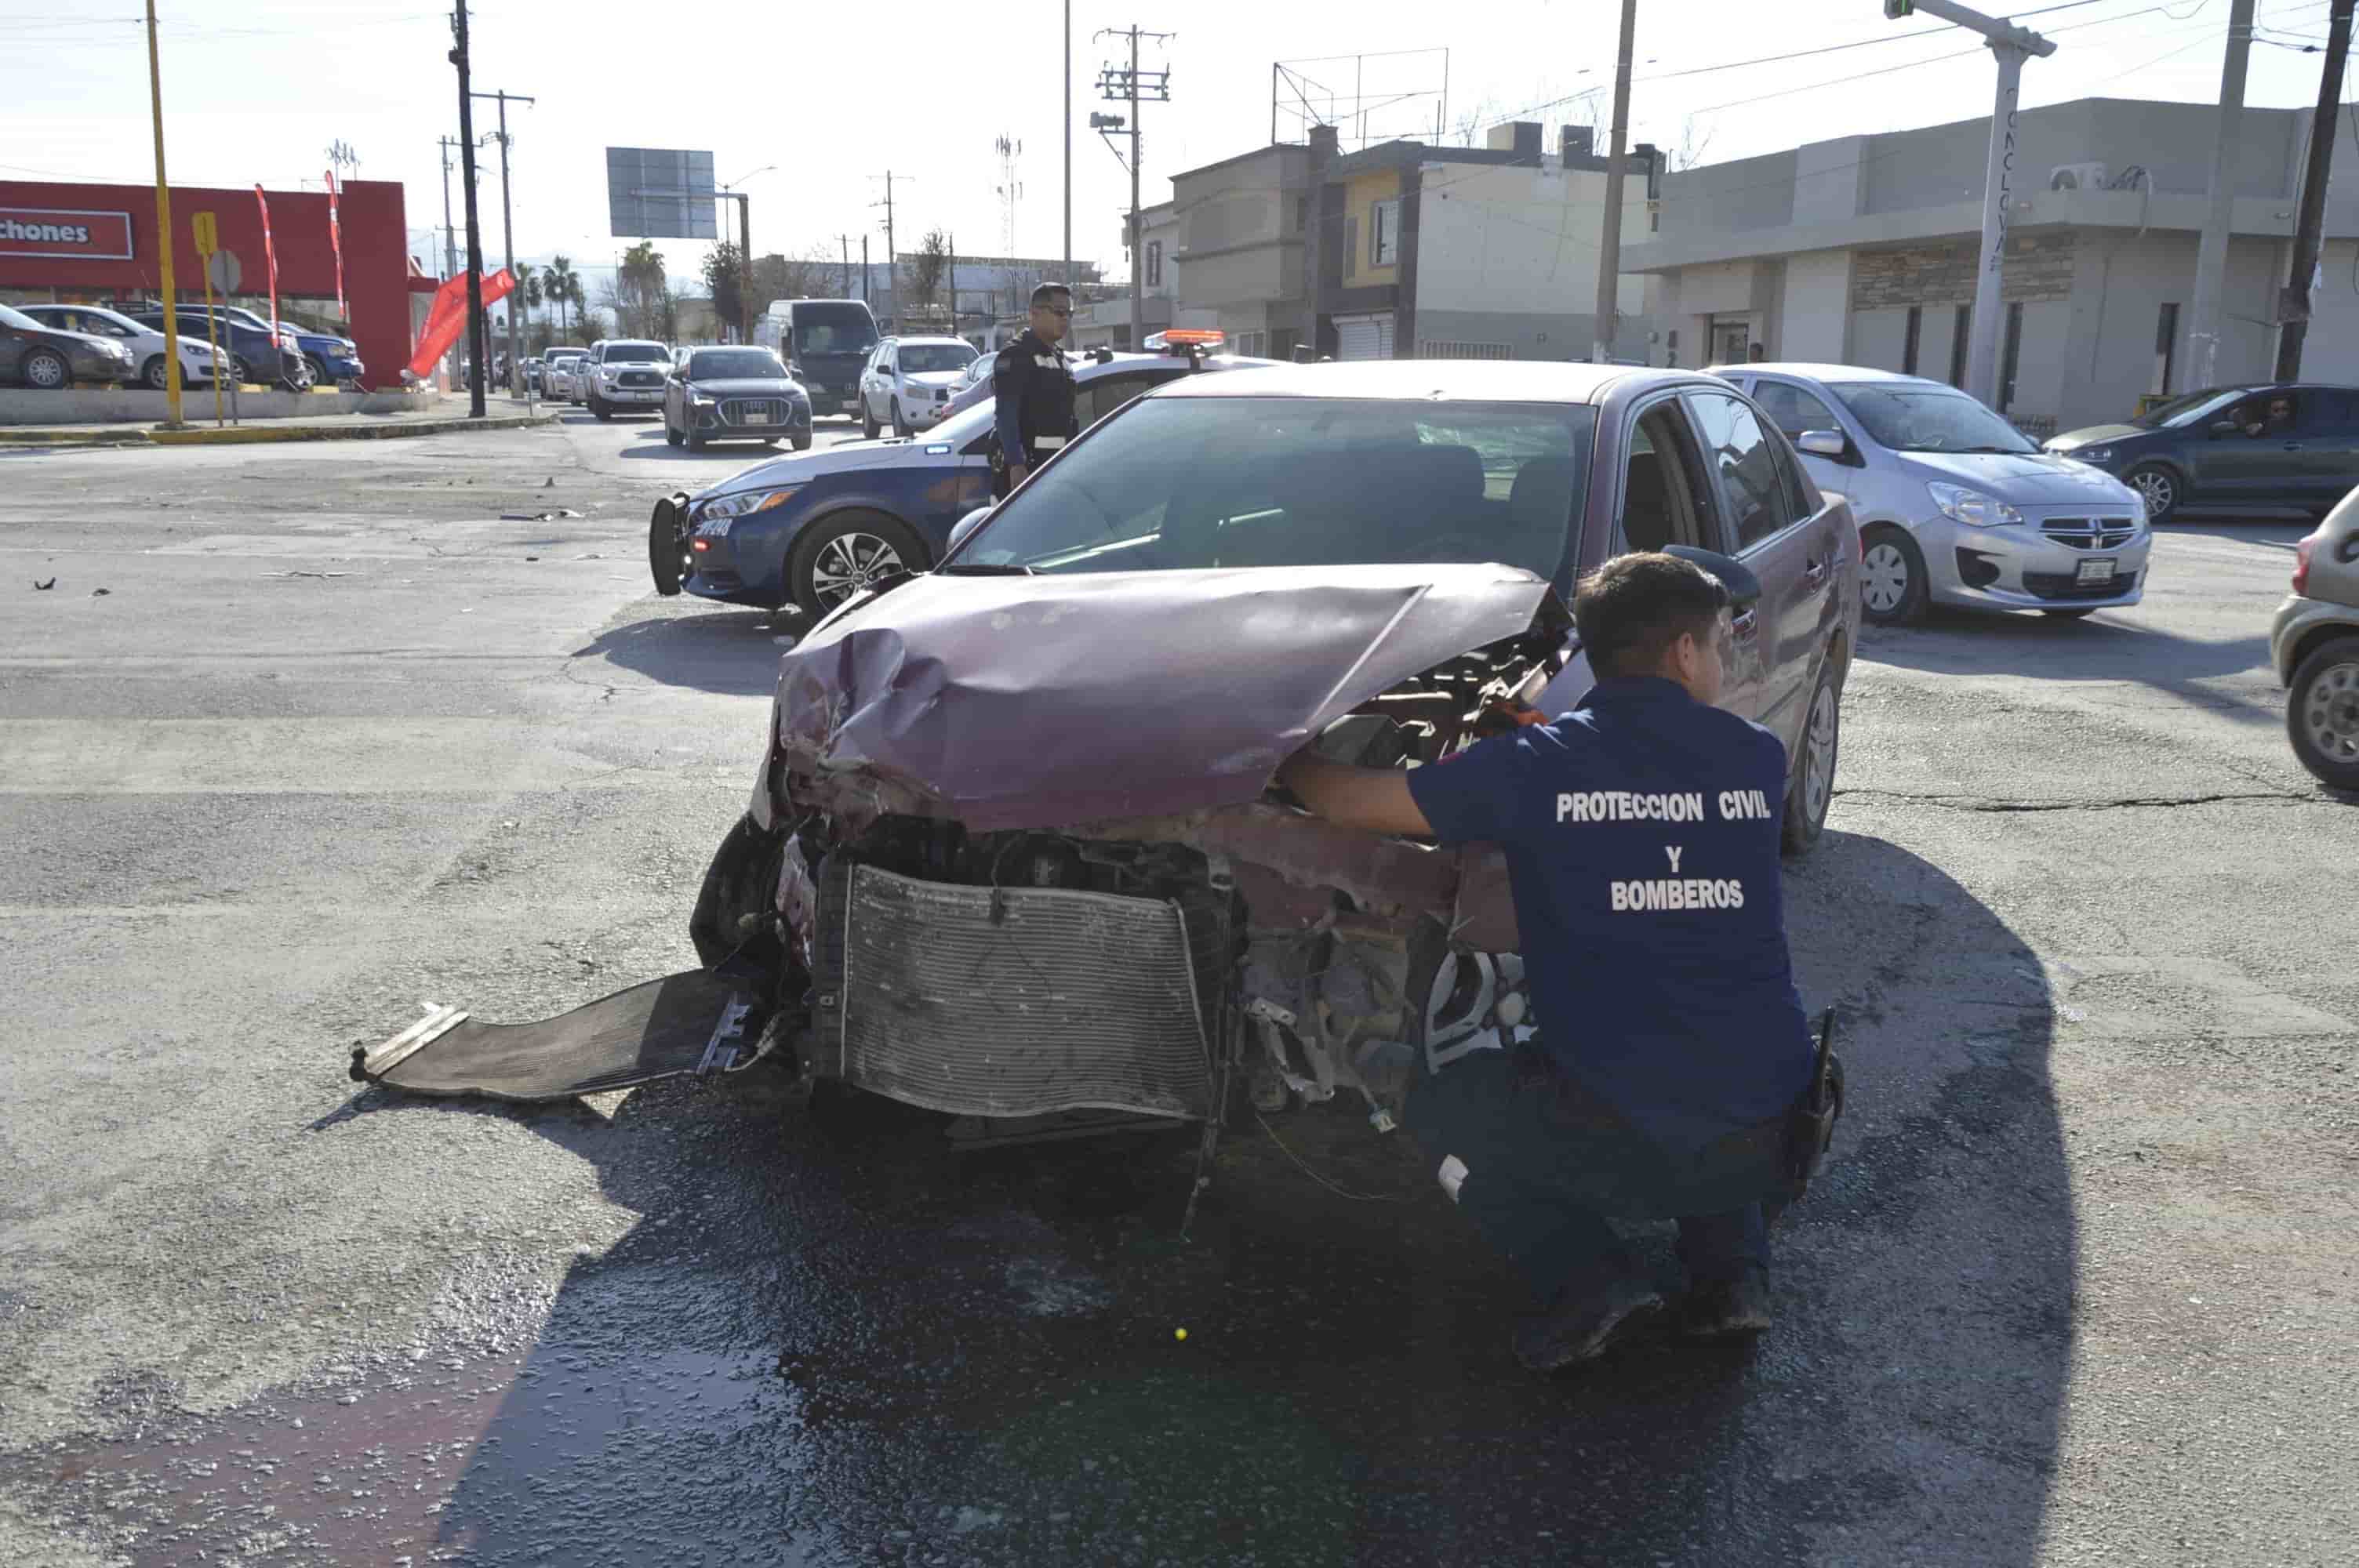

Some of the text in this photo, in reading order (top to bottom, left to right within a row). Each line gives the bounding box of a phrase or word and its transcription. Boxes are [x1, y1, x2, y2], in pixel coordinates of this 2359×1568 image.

[1556, 789, 1771, 822] PROTECCION CIVIL
[1665, 846, 1682, 873] Y
[1611, 879, 1744, 911] BOMBEROS
